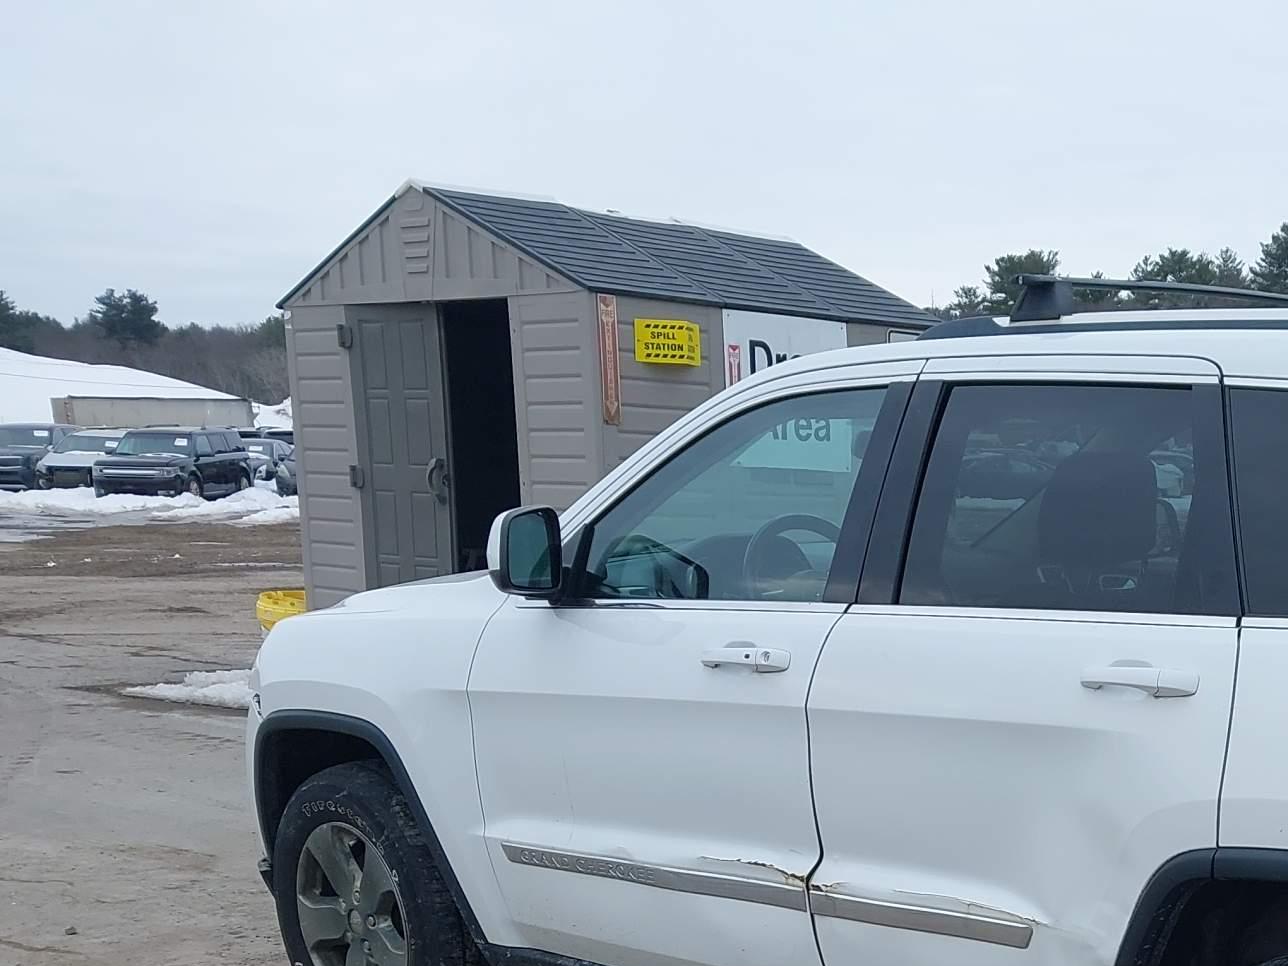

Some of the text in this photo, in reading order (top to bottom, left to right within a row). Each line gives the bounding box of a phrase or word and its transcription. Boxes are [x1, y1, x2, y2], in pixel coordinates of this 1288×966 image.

[650, 331, 677, 340] SPILL
[644, 342, 684, 352] STATION
[520, 849, 656, 883] GRAND CHEROKEE
